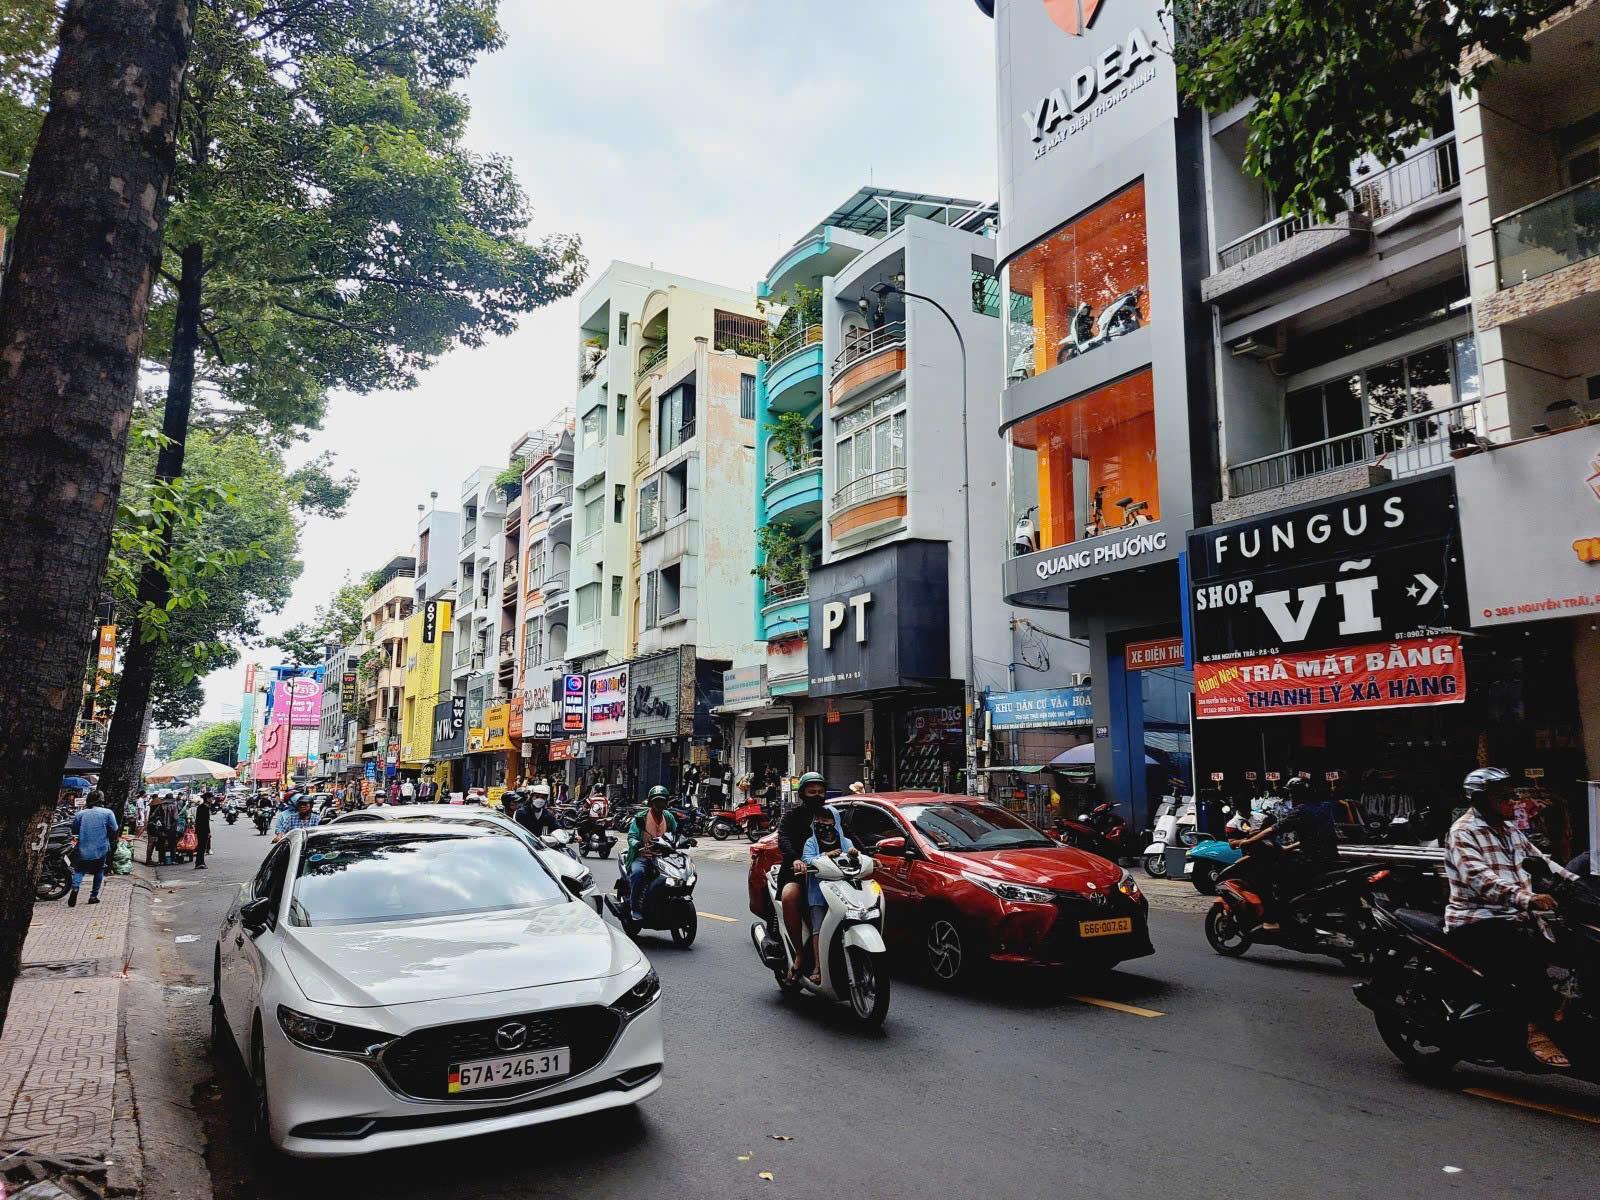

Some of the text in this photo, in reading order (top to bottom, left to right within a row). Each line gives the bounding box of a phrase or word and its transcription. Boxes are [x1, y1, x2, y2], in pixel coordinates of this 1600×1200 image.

[1022, 26, 1155, 143] YADEA
[1033, 68, 1156, 160] XE MÁY ĐIỆN THÔNG MINH
[1215, 496, 1405, 563] FUNGUS
[1036, 531, 1168, 580] QUANG PHƯƠNG
[1196, 580, 1254, 611] SHOP
[1255, 558, 1382, 643] VĨ
[1495, 607, 1515, 616] 386
[426, 603, 436, 641] 69+1
[822, 592, 872, 650] PT
[1131, 651, 1143, 663] XE
[1145, 647, 1166, 664] ĐIỆN
[1239, 643, 1454, 683] TRẢ MẶT BẰNG
[1198, 665, 1239, 694] Hàng New
[1246, 673, 1457, 709] THANH LÝ XẢ HÀNG
[995, 703, 1013, 713] KHU
[536, 724, 550, 732] 404
[460, 1054, 559, 1085] 67A-246.31
